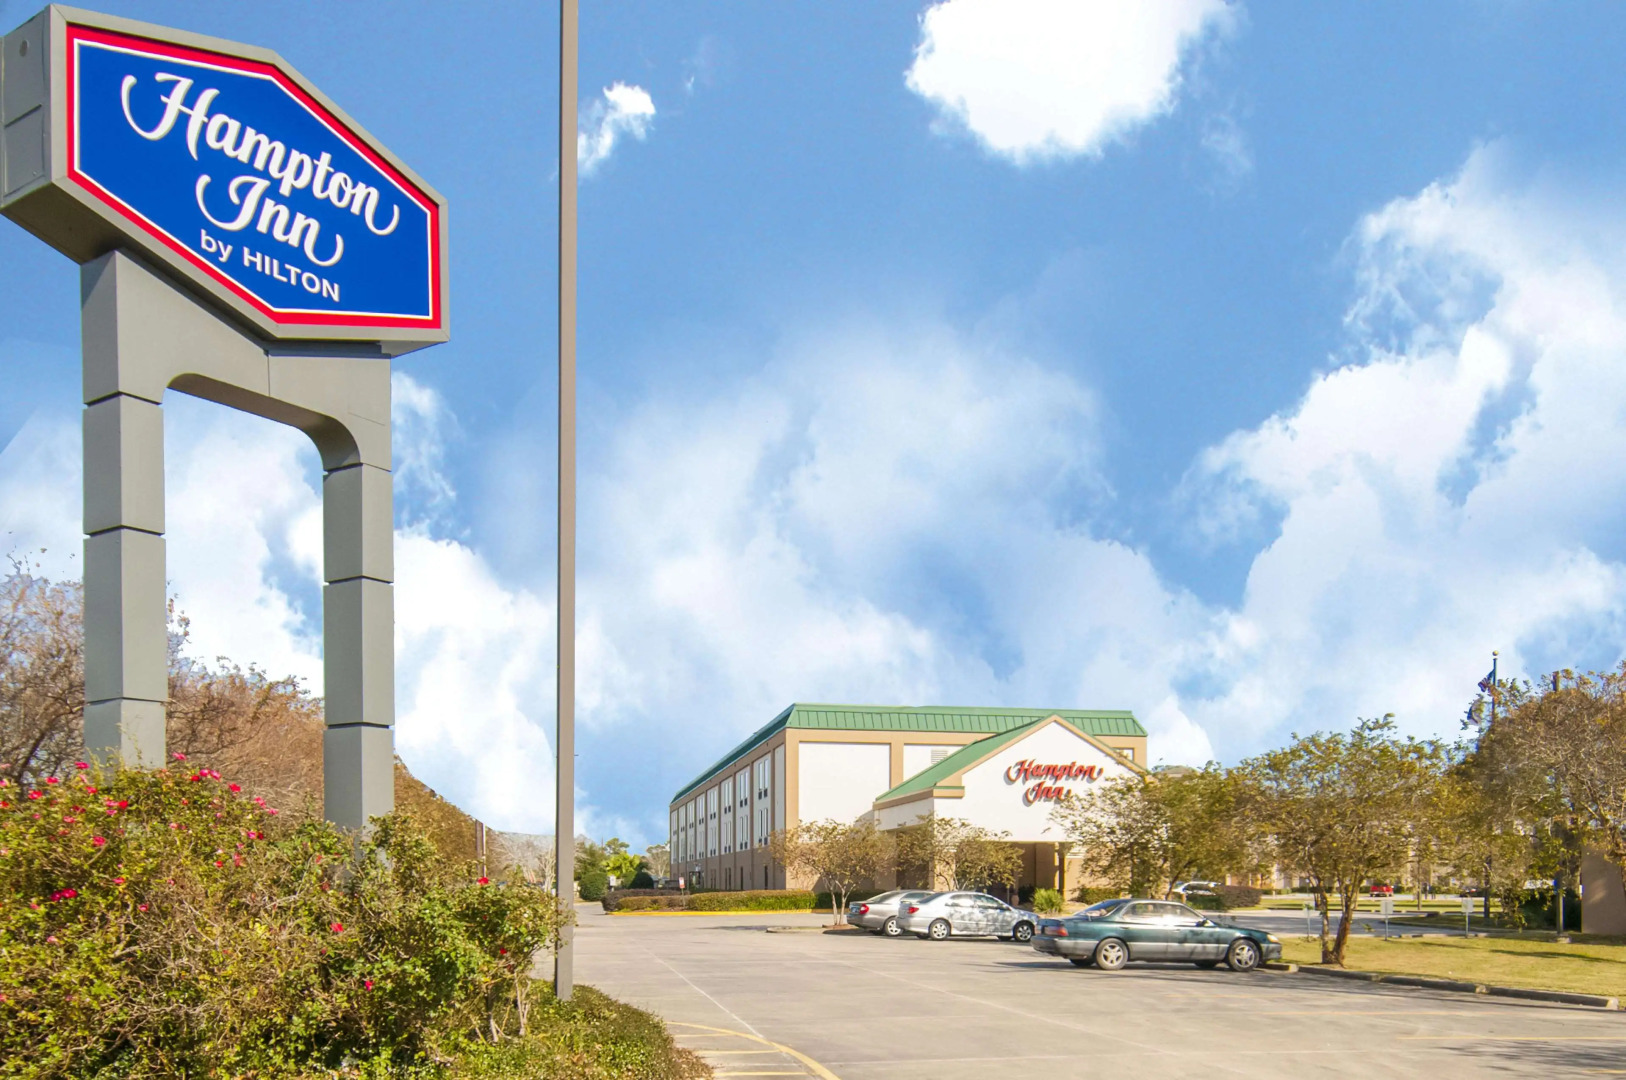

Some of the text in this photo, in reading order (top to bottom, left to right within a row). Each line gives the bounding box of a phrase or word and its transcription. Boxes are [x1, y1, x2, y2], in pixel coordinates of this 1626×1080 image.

[121, 72, 400, 236] Hampton
[195, 174, 344, 267] Inn
[200, 229, 341, 302] by HILTON
[1006, 759, 1104, 781] Hampton
[1025, 781, 1071, 804] Inn
